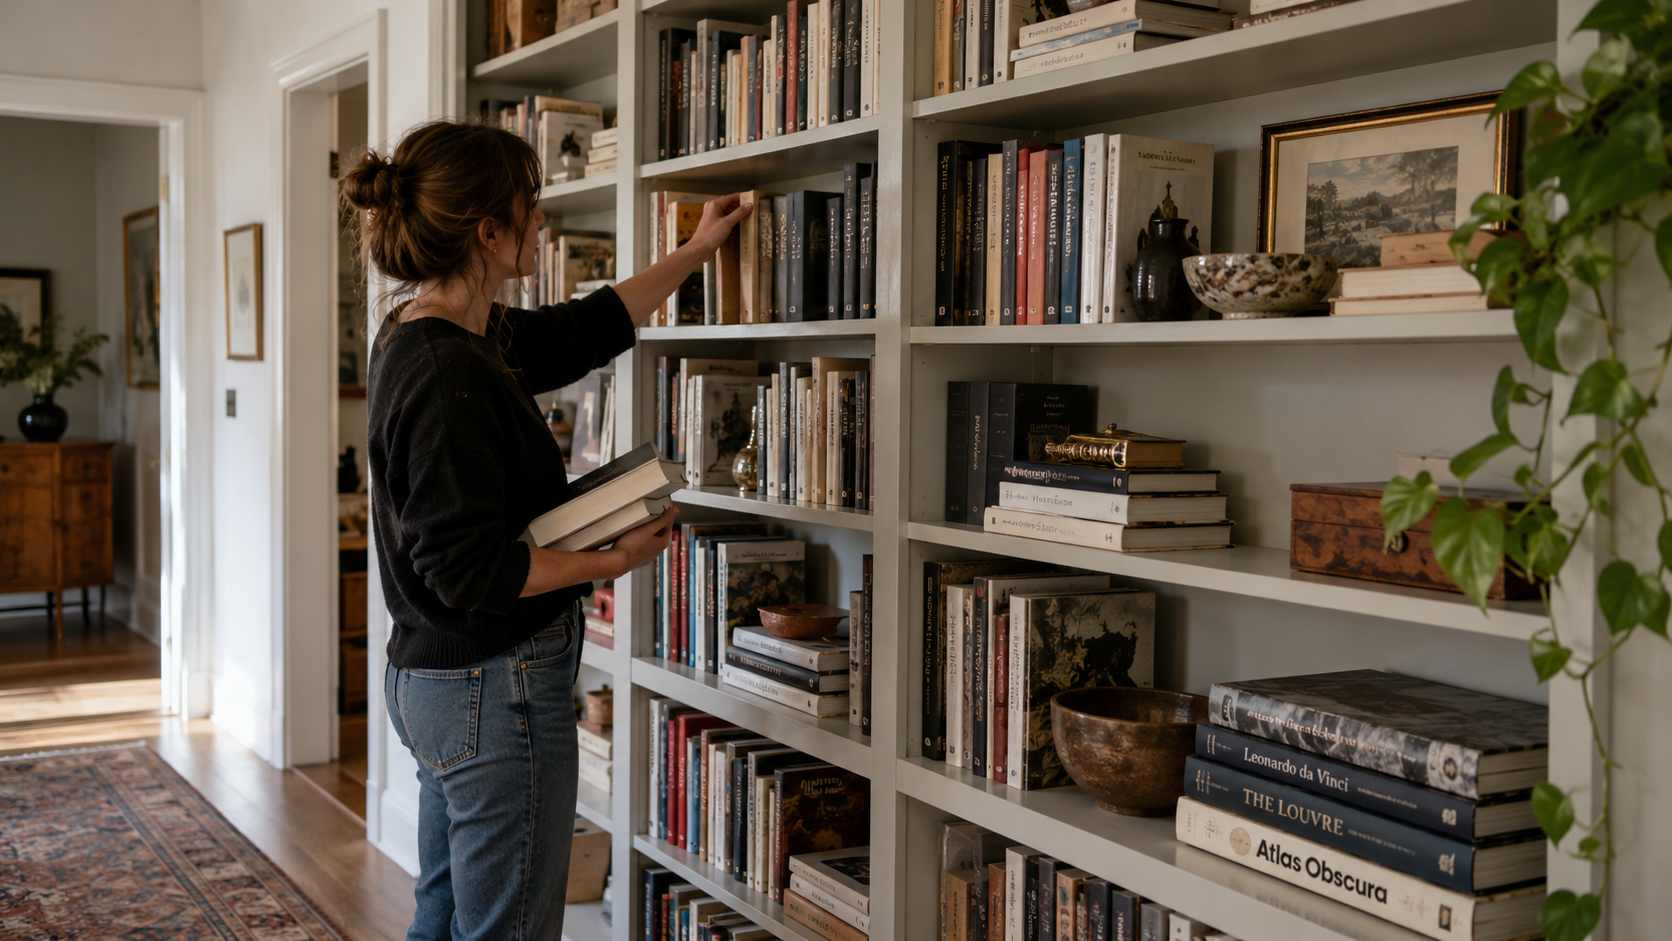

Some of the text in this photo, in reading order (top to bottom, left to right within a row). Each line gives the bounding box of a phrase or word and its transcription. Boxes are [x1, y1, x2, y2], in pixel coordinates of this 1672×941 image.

[1244, 747, 1349, 792] Leonardo da Vinci
[1242, 788, 1344, 836] THE LOUVRE
[1256, 838, 1302, 873] Atlas
[1305, 857, 1388, 904] Obscura
